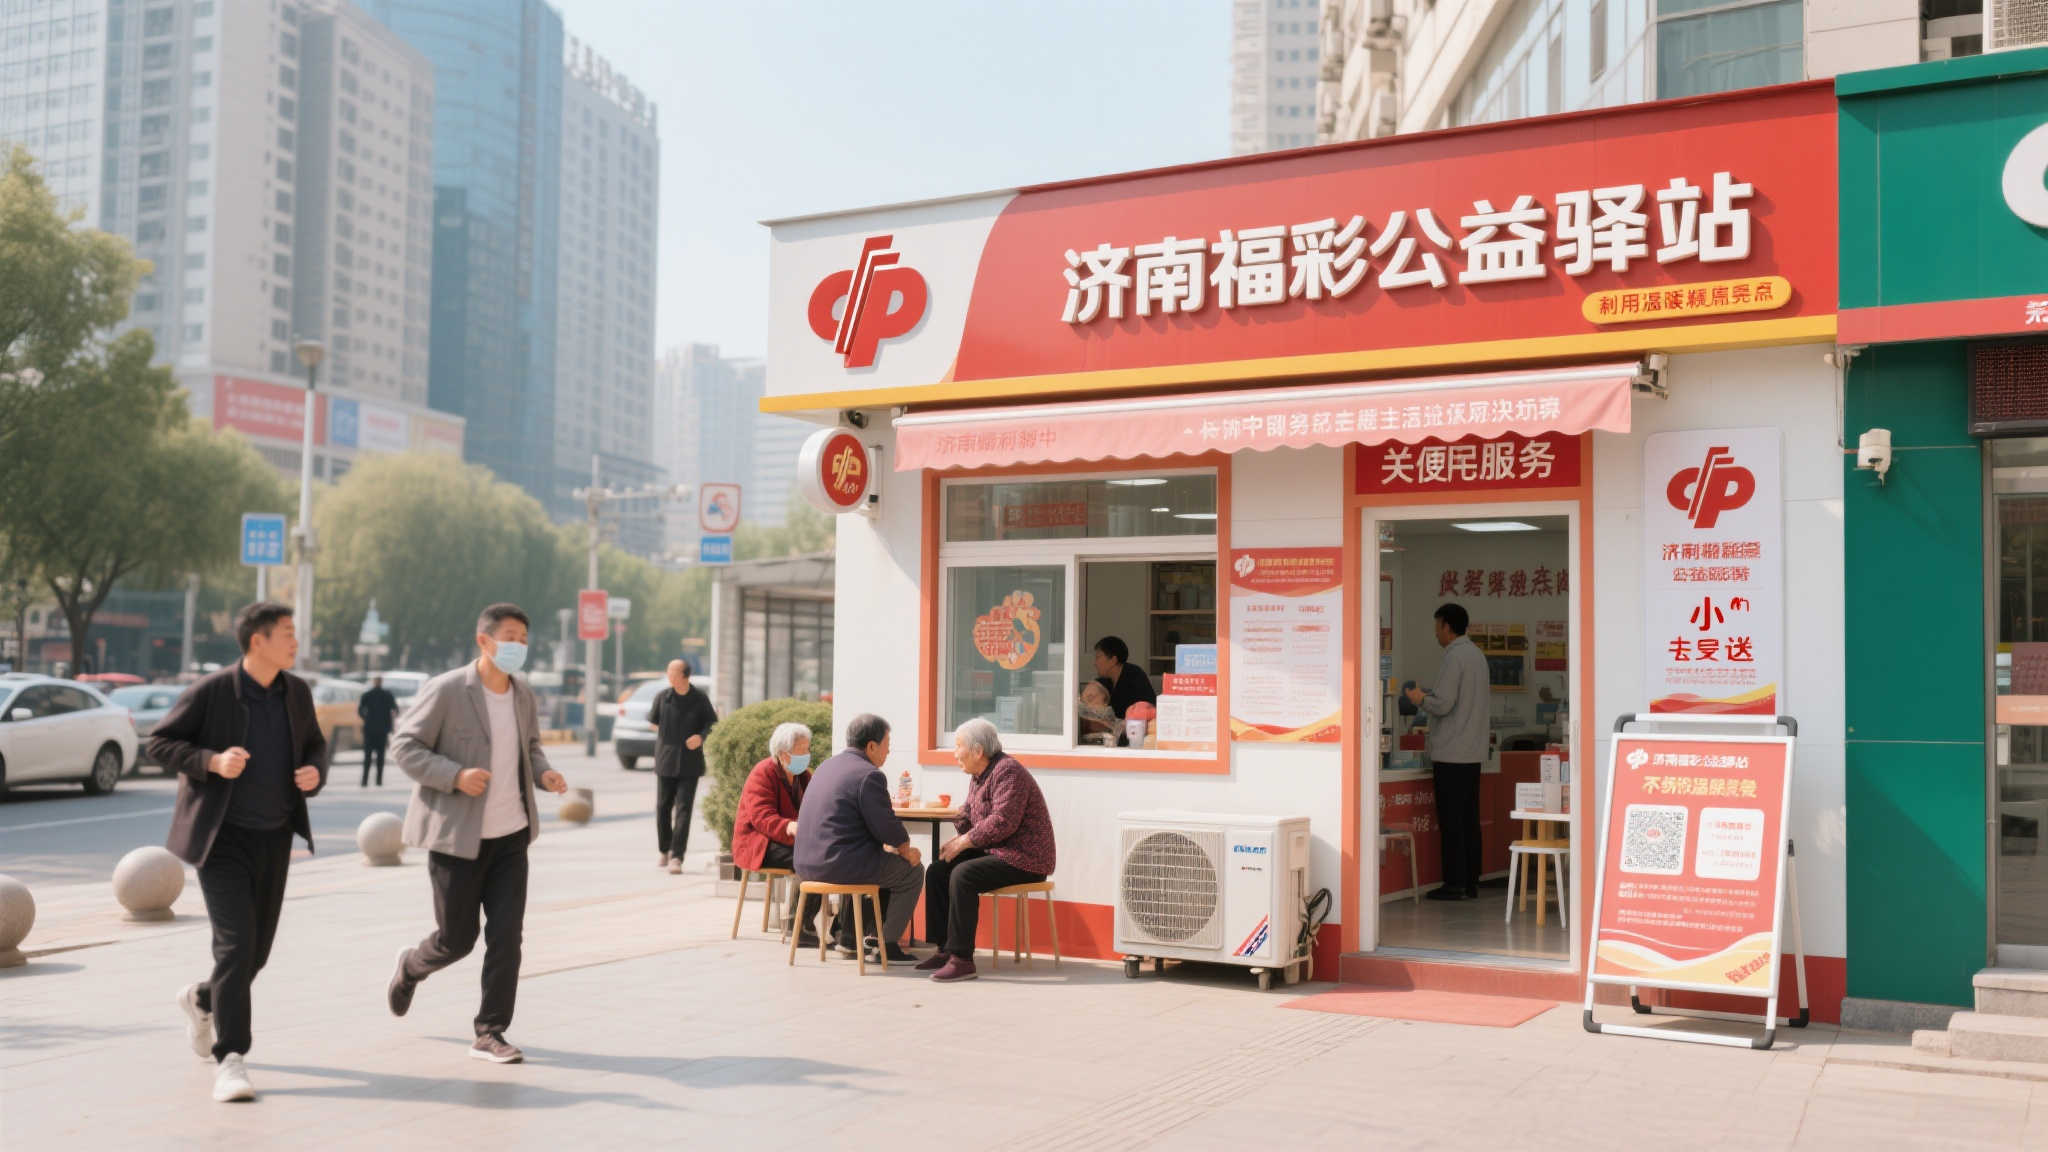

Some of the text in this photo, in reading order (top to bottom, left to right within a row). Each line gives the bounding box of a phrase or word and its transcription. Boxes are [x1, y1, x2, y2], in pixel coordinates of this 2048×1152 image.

[1061, 171, 1754, 324] 济南福彩公益驿站
